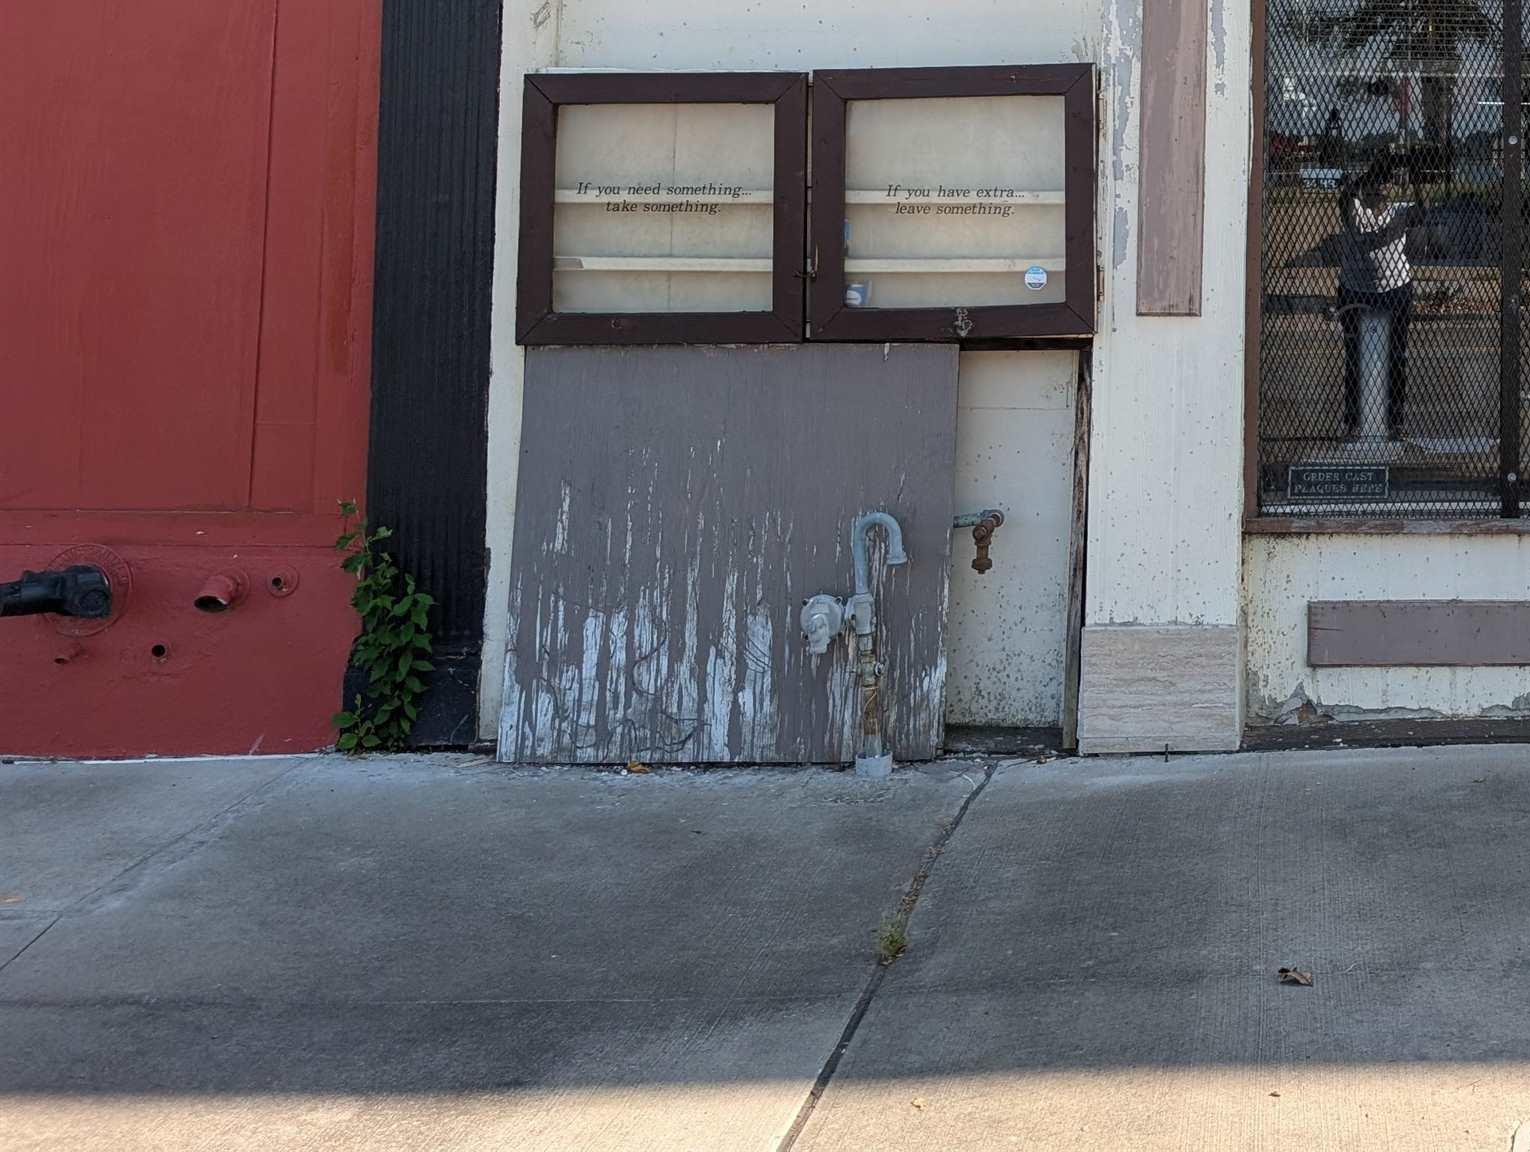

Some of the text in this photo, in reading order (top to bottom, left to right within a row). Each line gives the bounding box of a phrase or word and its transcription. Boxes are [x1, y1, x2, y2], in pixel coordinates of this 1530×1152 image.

[576, 181, 752, 199] If you need something...
[885, 184, 1026, 200] If you have extra...
[606, 199, 722, 216] take something.
[895, 201, 1016, 218] leave something.
